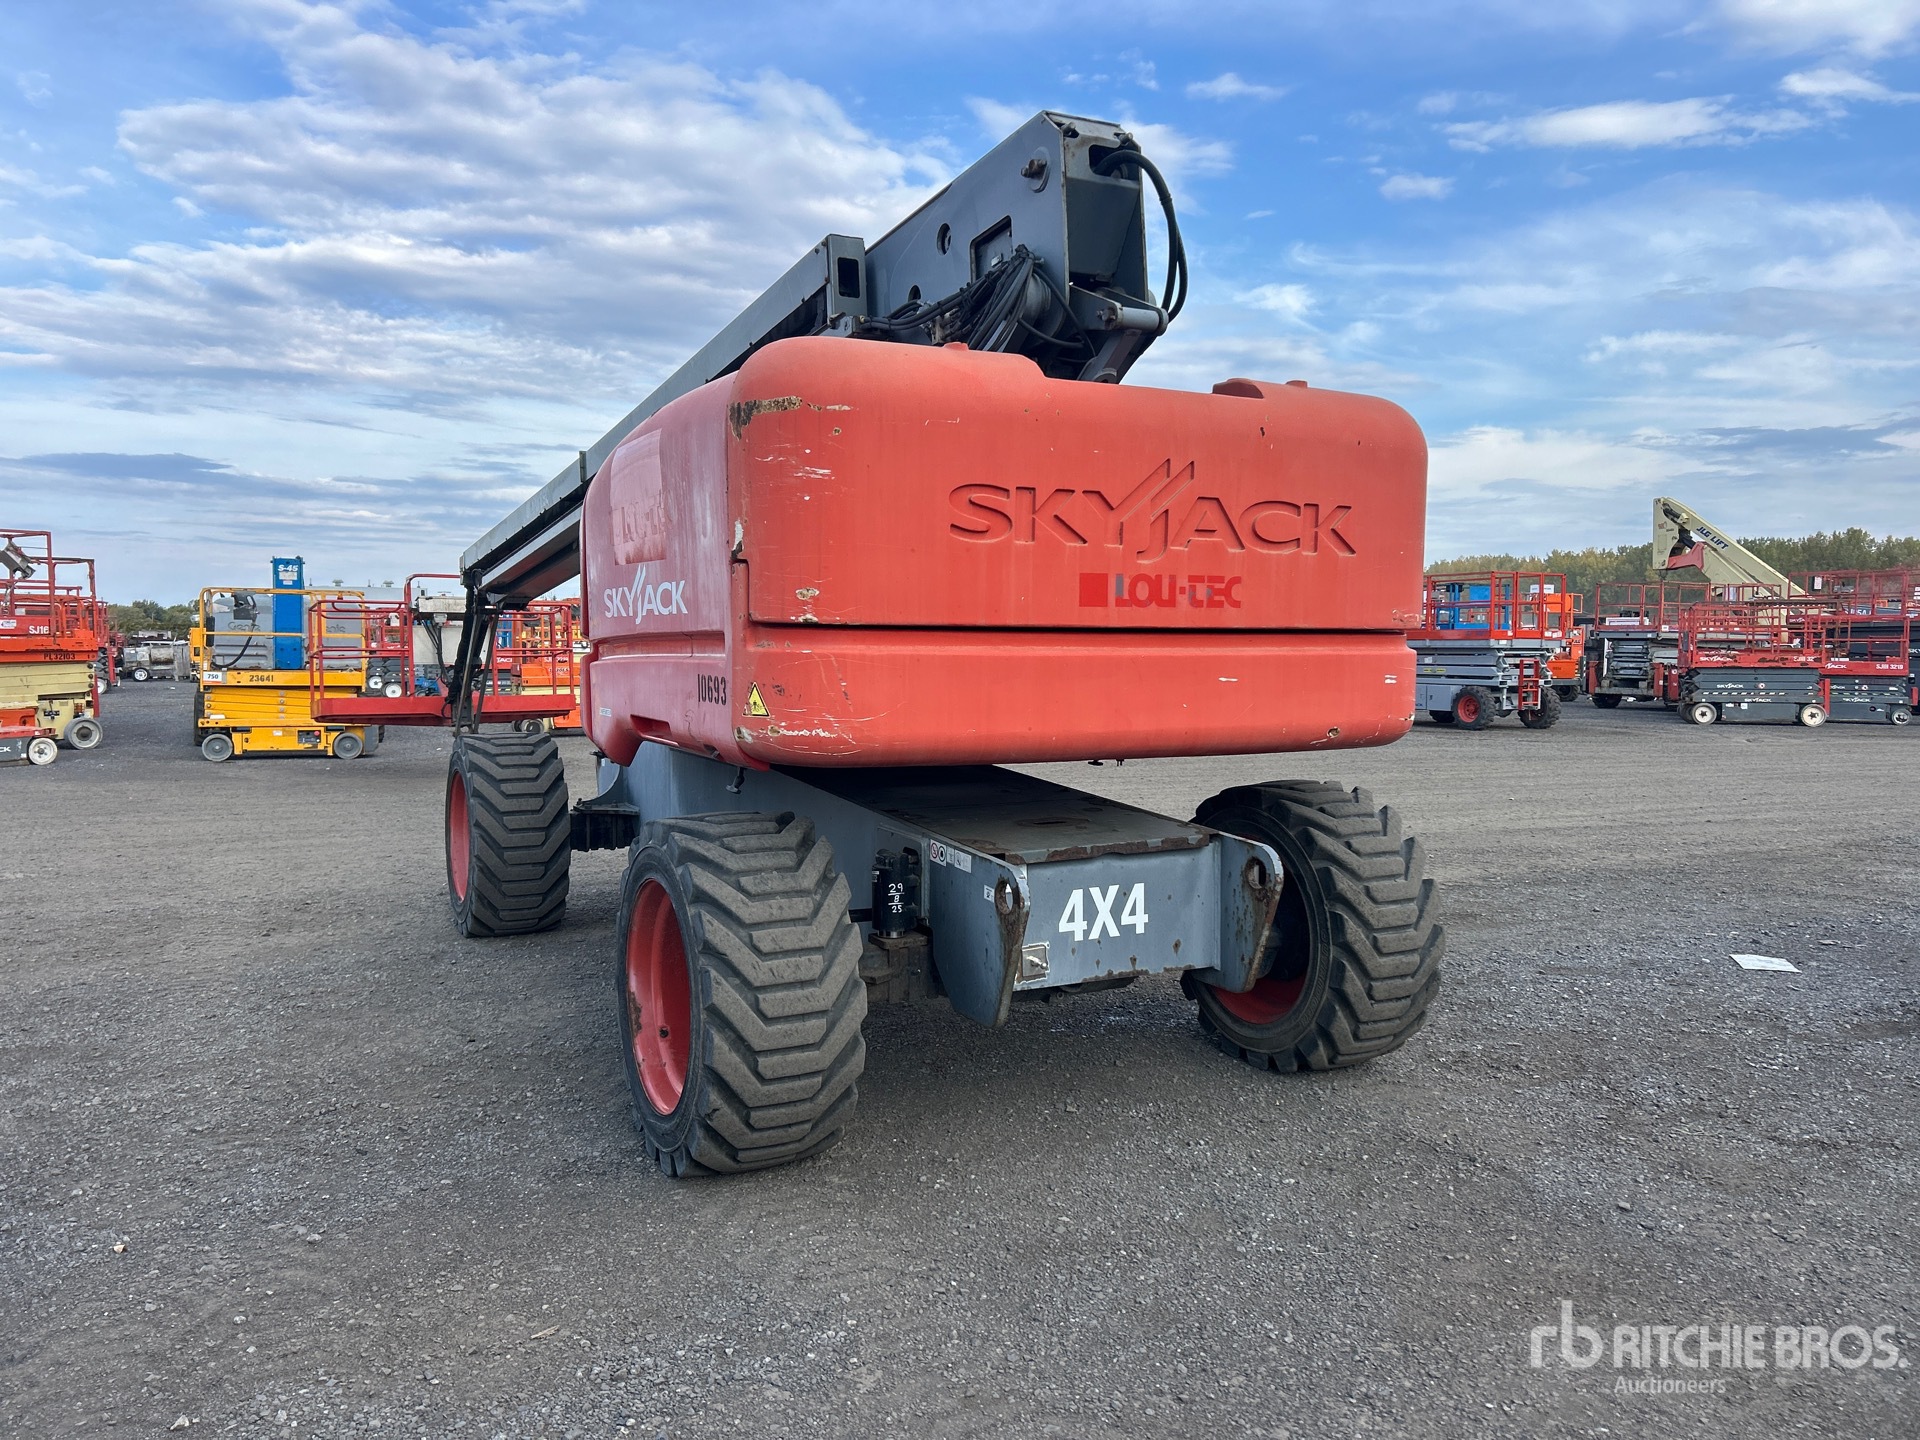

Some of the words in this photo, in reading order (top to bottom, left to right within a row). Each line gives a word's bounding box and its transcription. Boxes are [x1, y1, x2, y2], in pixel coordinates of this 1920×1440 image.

[949, 458, 1357, 564] SKYJACK
[1696, 526, 1712, 538] JLG
[1710, 535, 1729, 550] LIFT
[277, 564, 299, 572] S-45
[603, 563, 688, 625] SKYJACK
[249, 674, 274, 683] 23641
[697, 673, 727, 706] 10693
[888, 883, 904, 893] 29
[893, 895, 900, 903] 8
[891, 904, 902, 913] 25
[1058, 882, 1149, 942] 4X4
